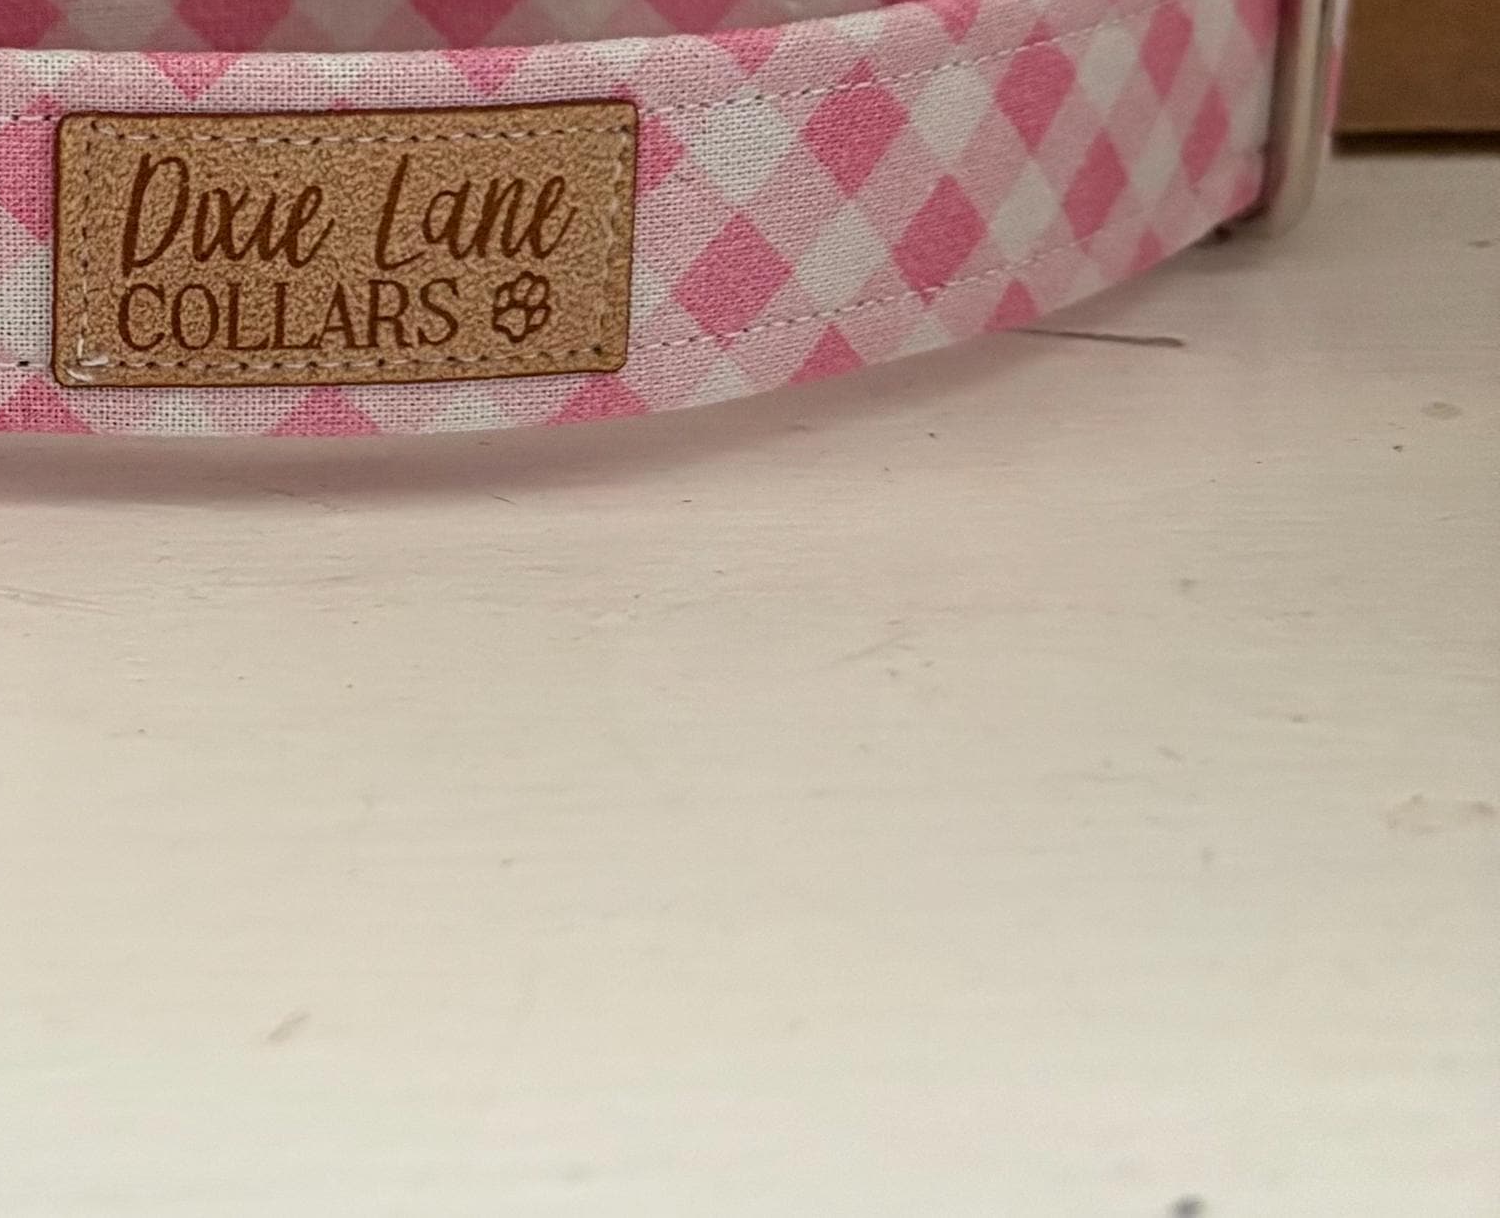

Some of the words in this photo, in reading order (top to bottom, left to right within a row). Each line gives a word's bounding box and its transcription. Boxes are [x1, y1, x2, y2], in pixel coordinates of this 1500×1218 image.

[122, 153, 335, 278] Dixie
[375, 154, 579, 271] Lane
[118, 277, 460, 351] COLLARS
